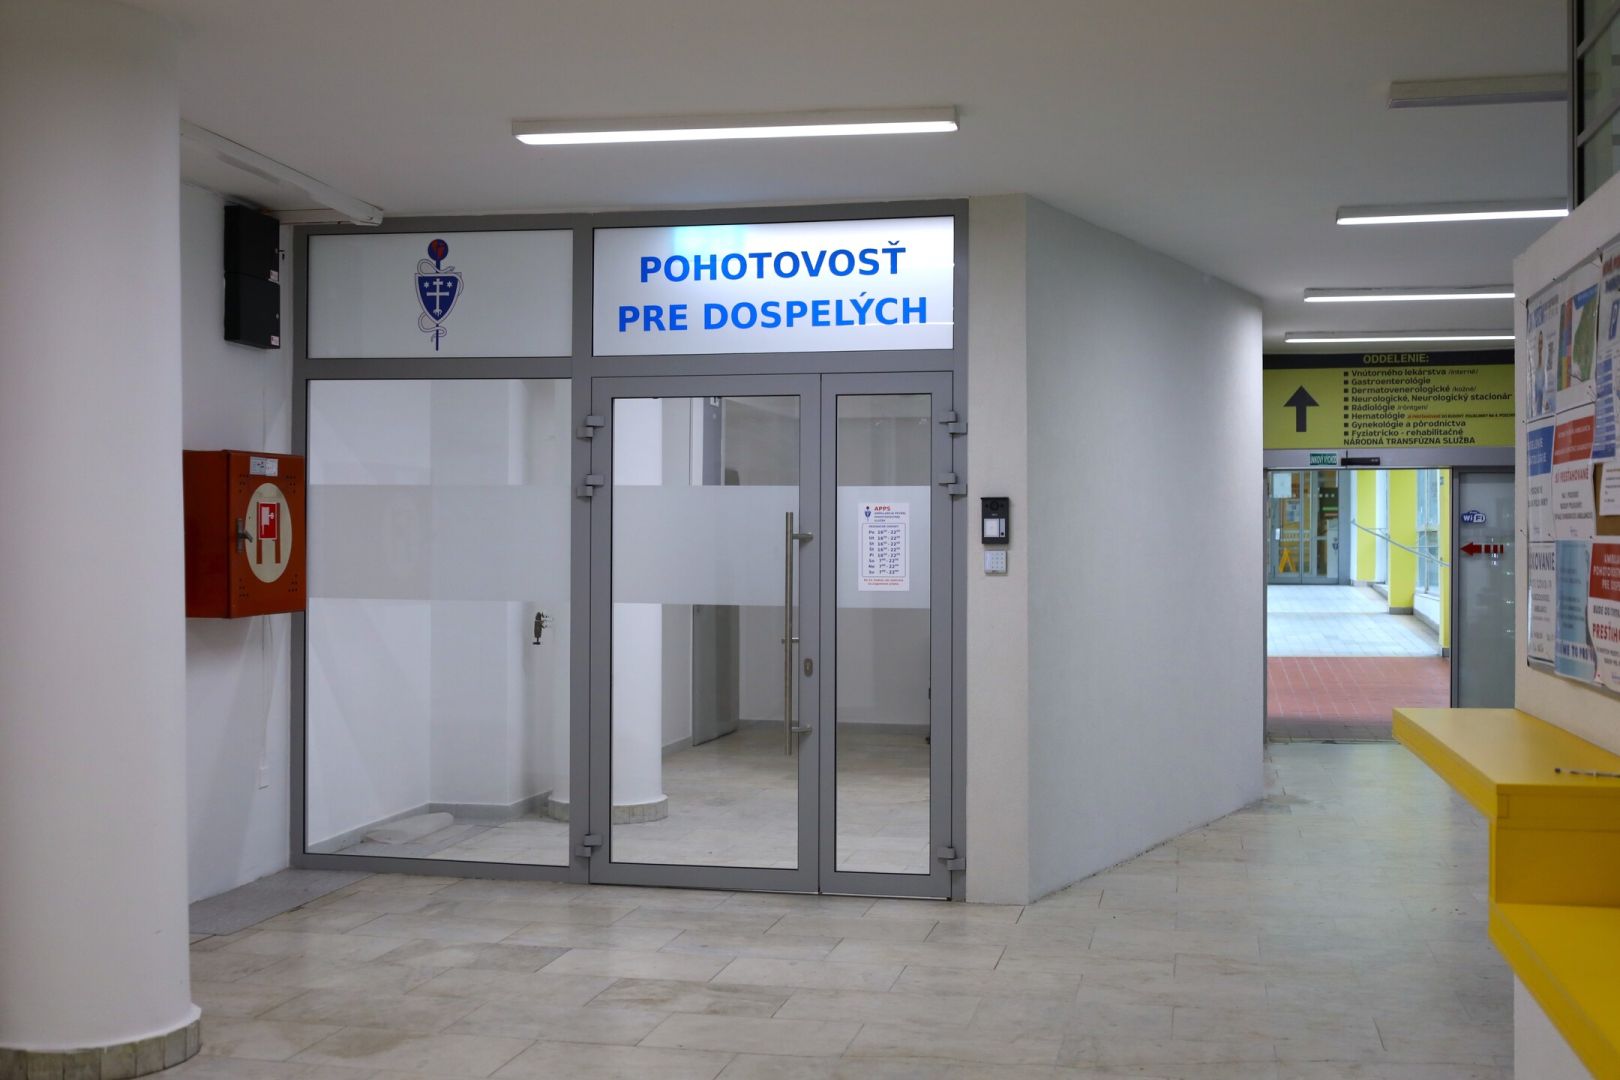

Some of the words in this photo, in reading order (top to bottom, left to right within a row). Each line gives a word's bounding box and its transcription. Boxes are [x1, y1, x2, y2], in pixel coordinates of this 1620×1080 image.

[640, 240, 906, 283] POHOTOVOSŤ
[618, 303, 688, 332] PRE
[704, 291, 927, 330] DOSPELÝCH
[1363, 353, 1429, 364] ODDELENIE:
[1343, 437, 1384, 446] NÁRODNÁ
[1443, 435, 1476, 445] SLUŽBA
